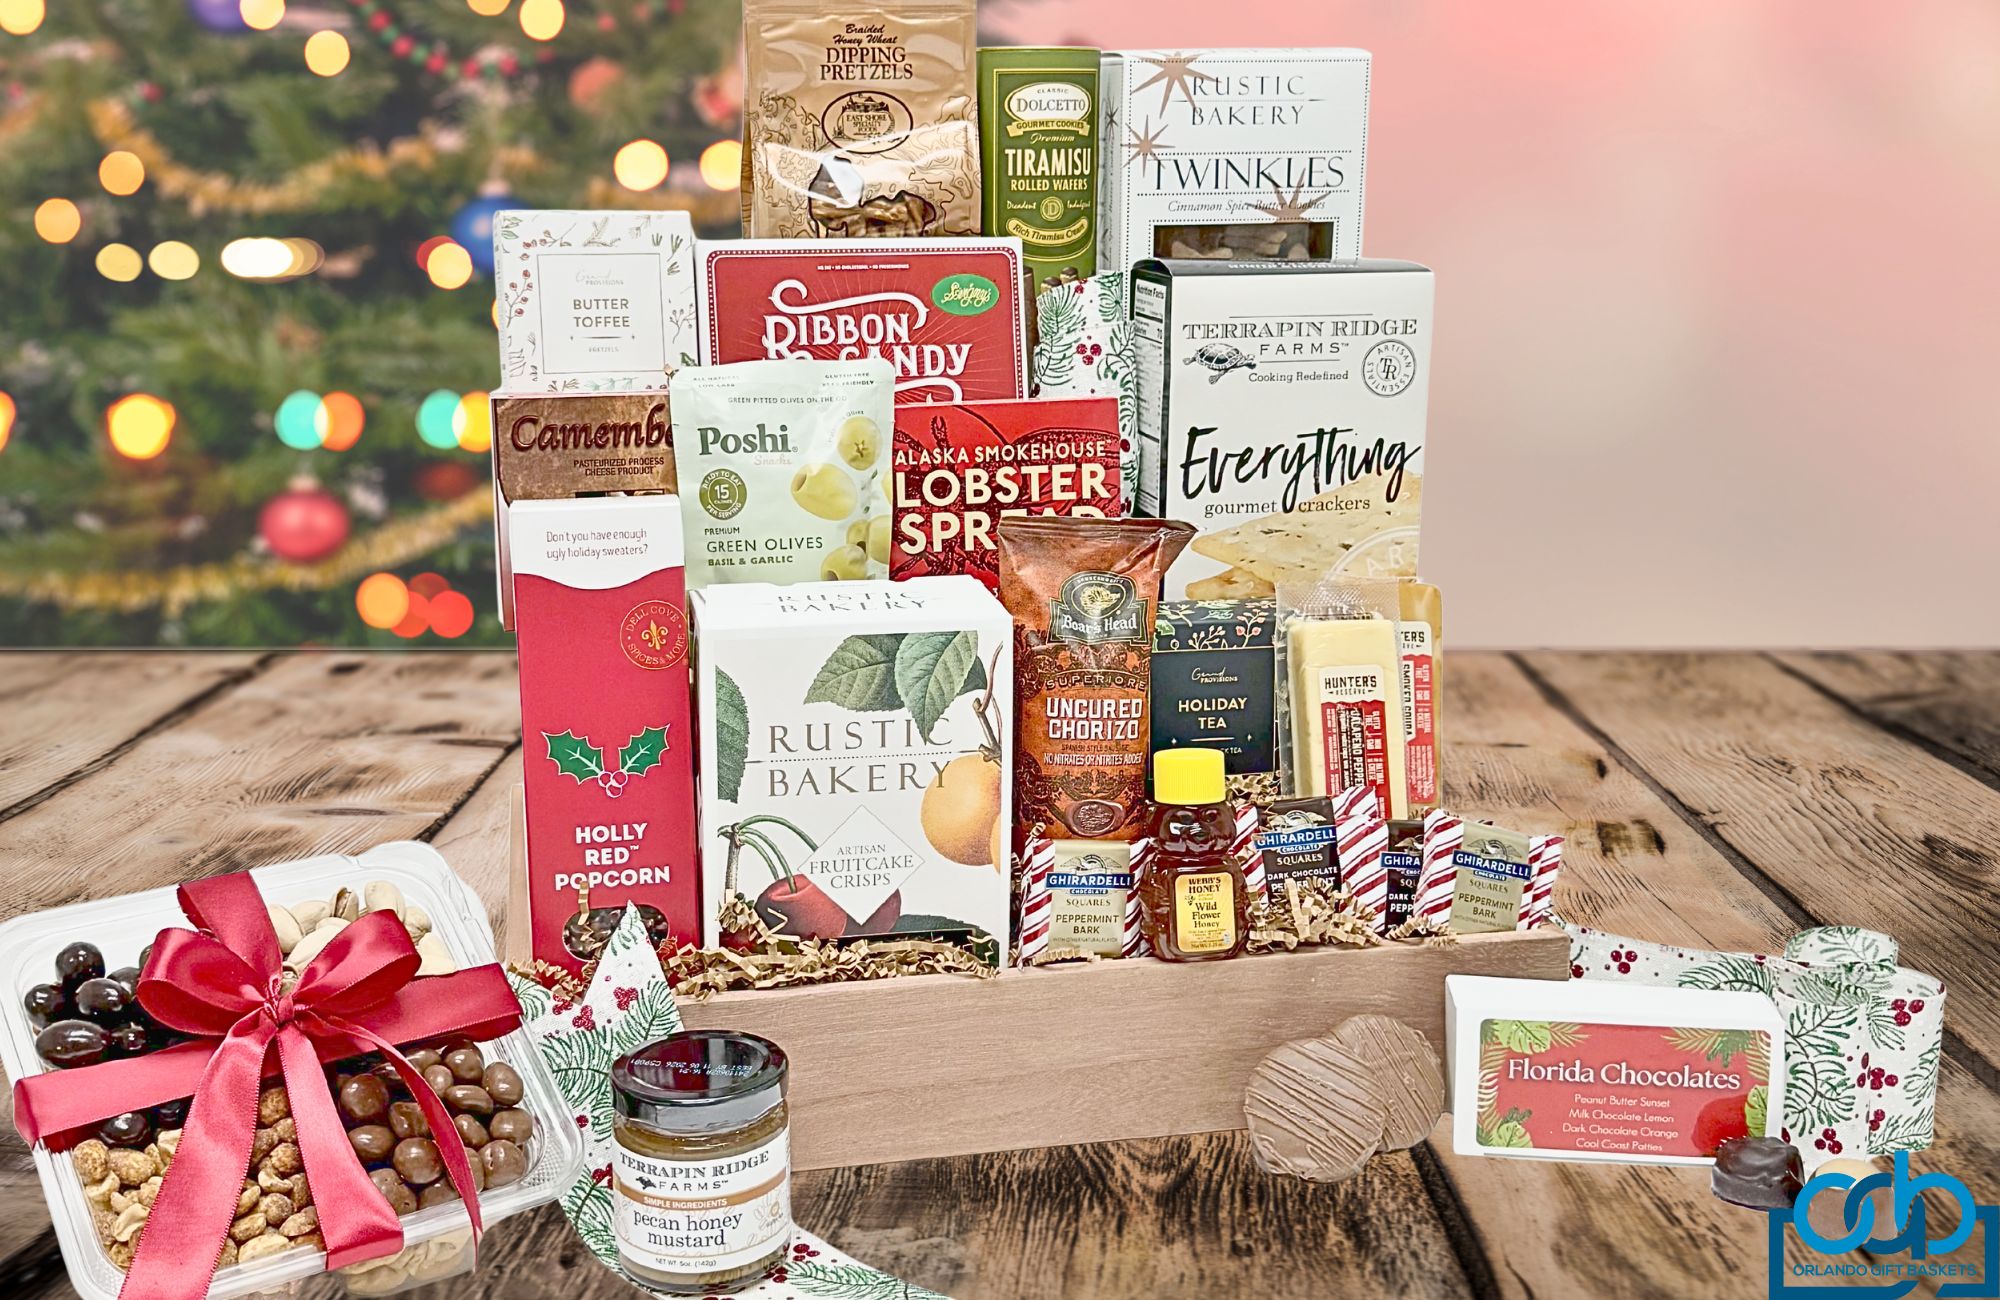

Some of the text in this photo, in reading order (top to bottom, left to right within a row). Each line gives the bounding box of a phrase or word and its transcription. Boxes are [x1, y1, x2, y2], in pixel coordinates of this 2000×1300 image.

[845, 23, 885, 34] Braided
[832, 34, 898, 46] Honey Wheat
[826, 47, 906, 63] DIPPING
[820, 64, 913, 80] PRETZELS
[1193, 75, 1306, 96] RUSTIC
[1016, 97, 1086, 113] DOLCETTO
[846, 114, 863, 122] EAST
[1191, 104, 1305, 126] BAKERY
[1016, 120, 1085, 130] GOURMET COOKIES
[1030, 133, 1075, 144] Premium
[1005, 148, 1091, 177] TIRAMISU
[1146, 155, 1345, 190] TWINKLES
[1010, 178, 1088, 191] ROLLED WAFERS
[1167, 198, 1326, 214] Cinnamon Spice Butter Cookies
[1012, 223, 1085, 241] Rich Tiramisu Cream
[573, 298, 629, 310] BUTTER
[574, 316, 631, 328] TOFFEE
[1182, 320, 1326, 340] TERRAPIN
[1330, 319, 1418, 337] RIDGE
[762, 313, 911, 360] RIBBON
[1248, 370, 1349, 384] Cooking Redefined
[895, 440, 1107, 466] ALASKA SMOKEHOUSE
[573, 457, 665, 468] PASTEURIZED PROCESS
[1179, 426, 1422, 514] Everything
[585, 466, 655, 476] CHEESE PRODUCT
[714, 484, 730, 499] 15
[895, 463, 1111, 508] LOBSTER
[1204, 496, 1371, 518] gourmet crackers
[546, 528, 647, 543] Don't you have enough
[704, 526, 740, 536] PREMIUM
[707, 537, 823, 553] GREEN OLIVES
[546, 544, 648, 562] ugly holiday sweaters?
[708, 555, 794, 567] BASIL & GARLIC
[778, 592, 917, 603] RUSTIC
[781, 600, 926, 613] BAKERY
[626, 605, 680, 632] DELL COVE
[1061, 613, 1138, 634] Boar's Head
[628, 634, 685, 665] SPICES MORE
[1046, 675, 1146, 690] SUPERIORE
[1200, 676, 1238, 684] PROVISIONS
[1324, 675, 1377, 690] HUNTER'S
[1335, 688, 1366, 696] RESERVE
[1046, 697, 1143, 718] UNCURED
[1178, 697, 1248, 713] HOLIDAY
[1048, 719, 1139, 740] CHORIZO
[1198, 717, 1227, 730] TEA
[768, 717, 953, 754] RUSTIC
[1350, 709, 1365, 755] JALAPEÑO
[1229, 746, 1242, 754] TEA
[1044, 753, 1053, 764] NO
[1053, 754, 1085, 766] NITRATES
[1095, 754, 1123, 766] NITRITES
[768, 760, 952, 797] BAKERY
[575, 823, 648, 844] HOLLY
[836, 843, 886, 855] ARTISAN
[810, 855, 914, 875] FRUITCAKE
[1276, 853, 1323, 866] SQUARES
[1456, 854, 1530, 878] GHIRARDELLI
[555, 866, 671, 891] POPCORN
[830, 873, 891, 889] CRISPS
[1049, 874, 1131, 887] GHIRARDELLI
[1267, 866, 1338, 882] DARK CHOCOLATE
[1473, 869, 1507, 881] CHOCOLATE
[1188, 884, 1221, 893] HONEY
[1469, 878, 1509, 894] SQUARES
[1066, 898, 1111, 908] SQUARES
[1389, 893, 1410, 901] DARK
[1458, 892, 1514, 912] PEPPERMINT
[1195, 901, 1217, 911] Wild
[1472, 906, 1497, 919] BARK
[1055, 914, 1119, 924] PEPPERMINT
[1192, 911, 1221, 920] Flower
[1073, 925, 1100, 935] BARK
[1194, 920, 1220, 928] Honey
[1508, 1058, 1741, 1091] Florida Chocolates
[1574, 1093, 1670, 1108] Peanut Butter Sunset
[1568, 1108, 1674, 1123] Milk Chocolate Lemon
[1562, 1123, 1679, 1140] Dark Chocolate Orange
[1576, 1138, 1663, 1152] Cool Coast Patties
[620, 1151, 769, 1178] TERRAPIN RIDGE
[644, 1197, 728, 1209] SIMPLE INGREDIENTS
[633, 1210, 680, 1231] pecan
[687, 1213, 743, 1231] honey
[647, 1229, 726, 1248] mustard
